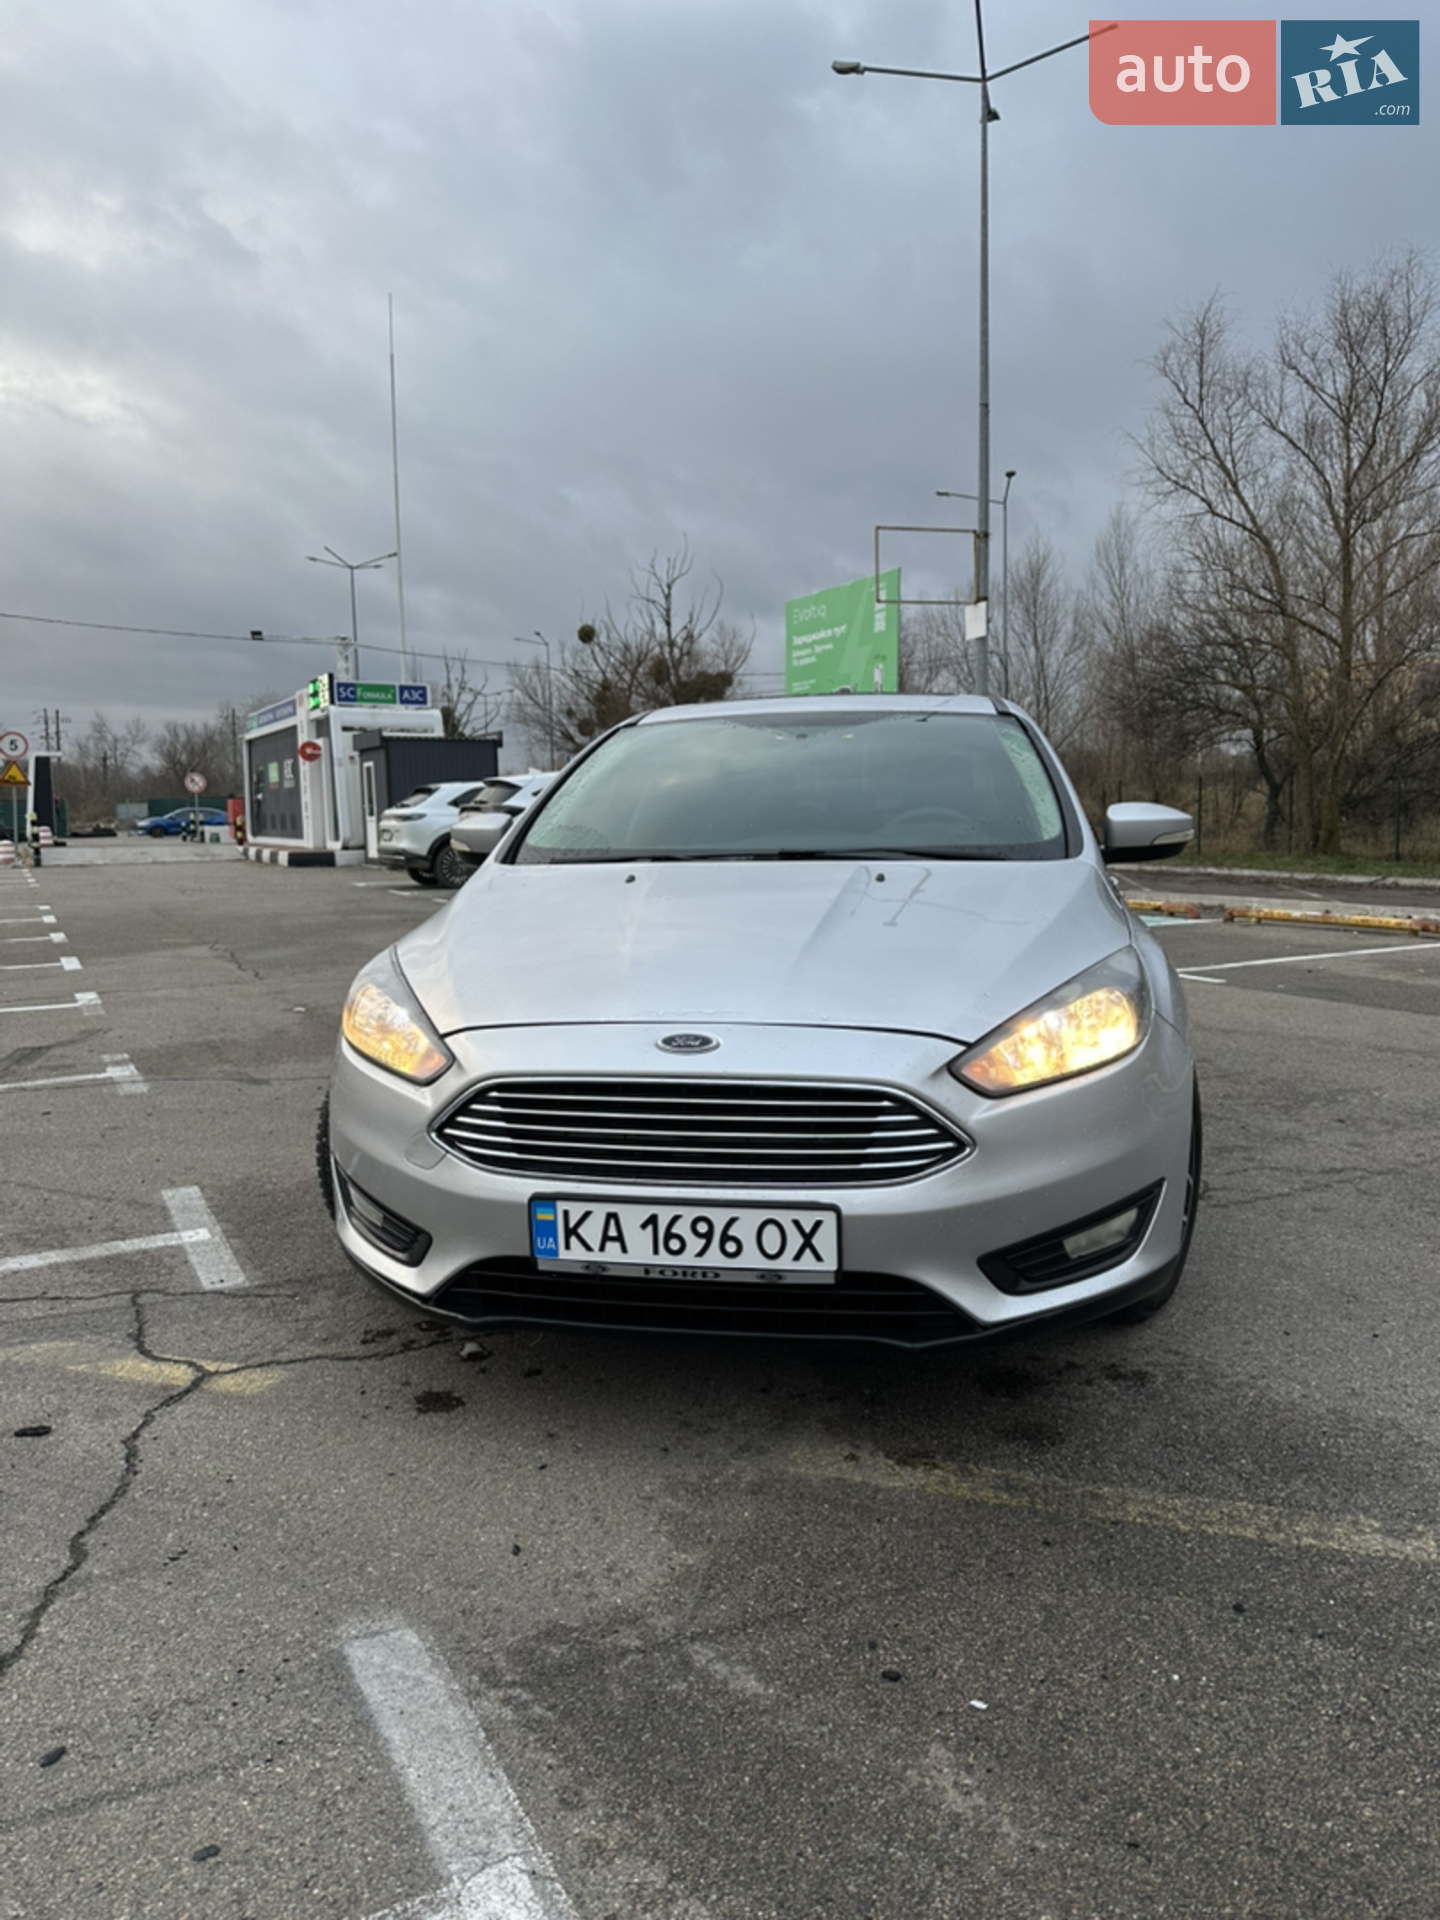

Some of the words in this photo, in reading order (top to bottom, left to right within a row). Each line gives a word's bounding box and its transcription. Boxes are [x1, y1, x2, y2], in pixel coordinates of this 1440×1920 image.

[9, 739, 18, 751] 5
[562, 1209, 628, 1254] KA
[639, 1213, 744, 1259] 1696
[755, 1217, 825, 1263] OX
[536, 1236, 556, 1250] UA
[642, 1267, 721, 1280] FORD
